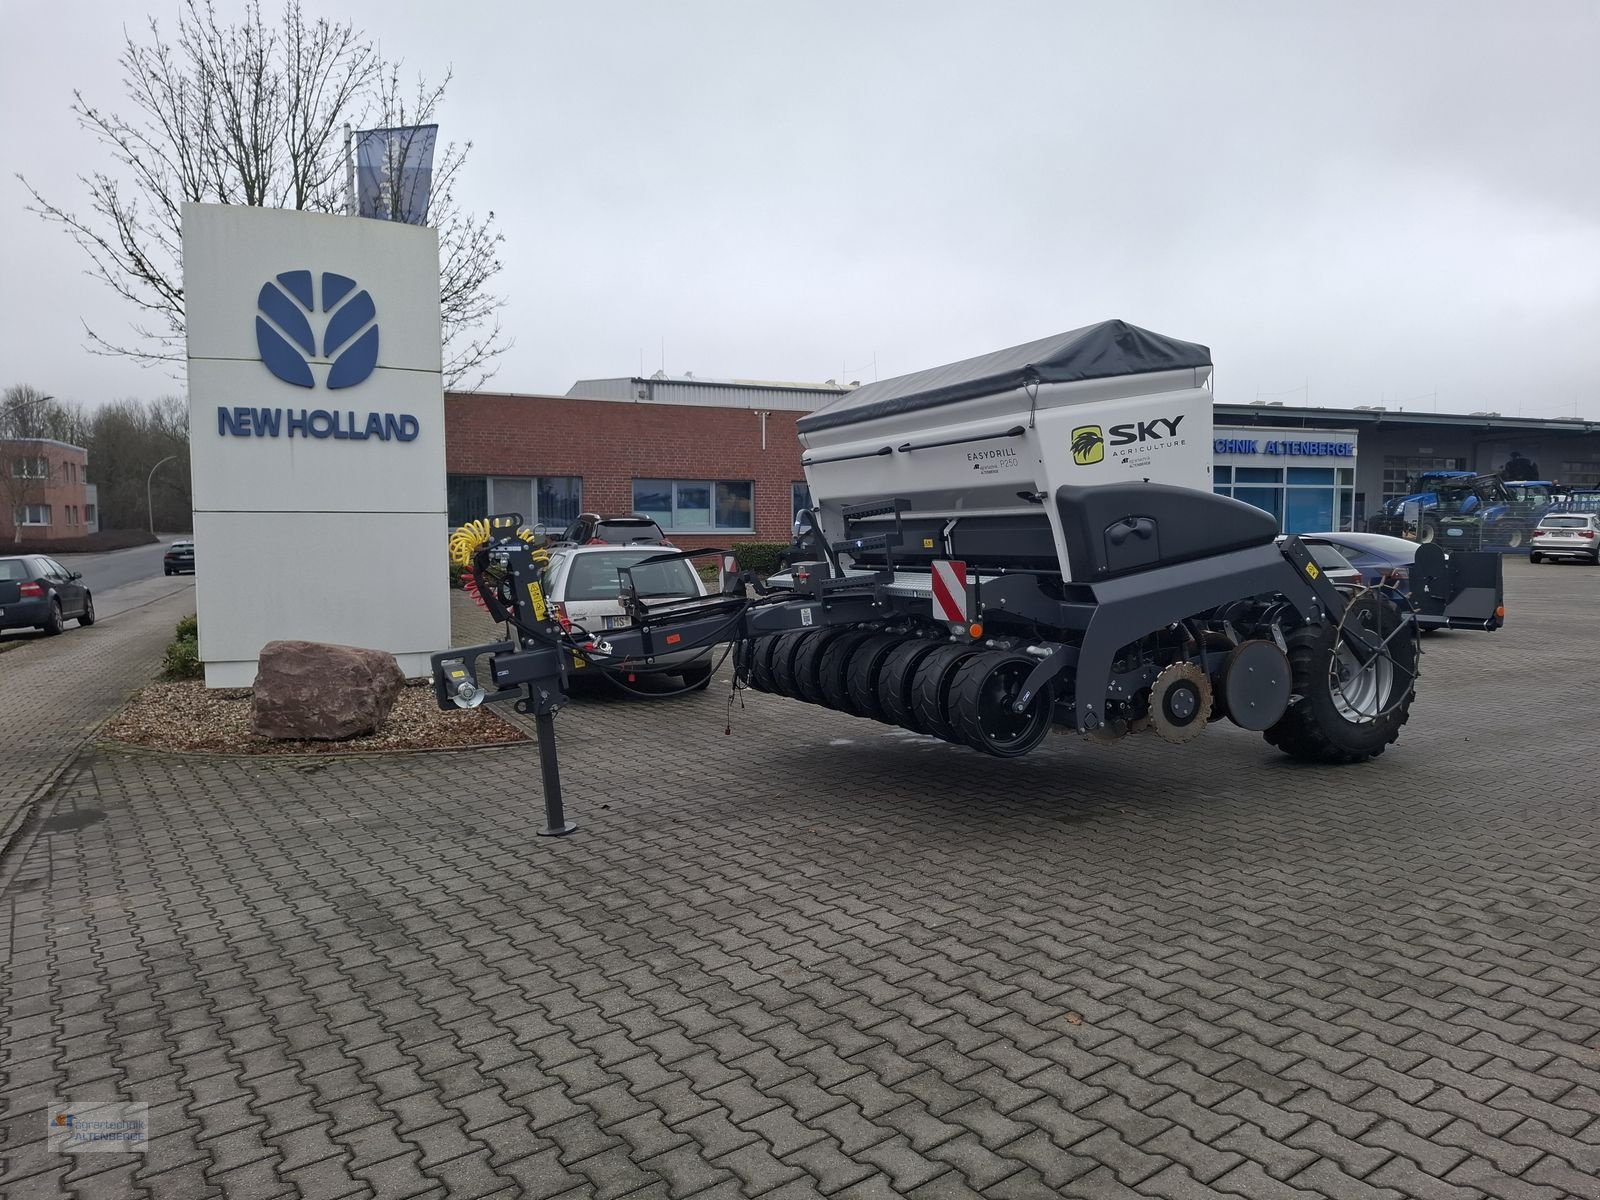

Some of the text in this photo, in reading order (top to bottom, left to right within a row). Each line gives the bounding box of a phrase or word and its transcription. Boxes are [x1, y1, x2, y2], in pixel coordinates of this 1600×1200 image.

[217, 406, 420, 442] NEW HOLLAND
[1108, 414, 1185, 446] SKY
[967, 447, 1017, 461] EASYDRILL
[1112, 439, 1186, 457] AGRICULTURE
[1213, 438, 1355, 457] CHNIK ALTENBERGE
